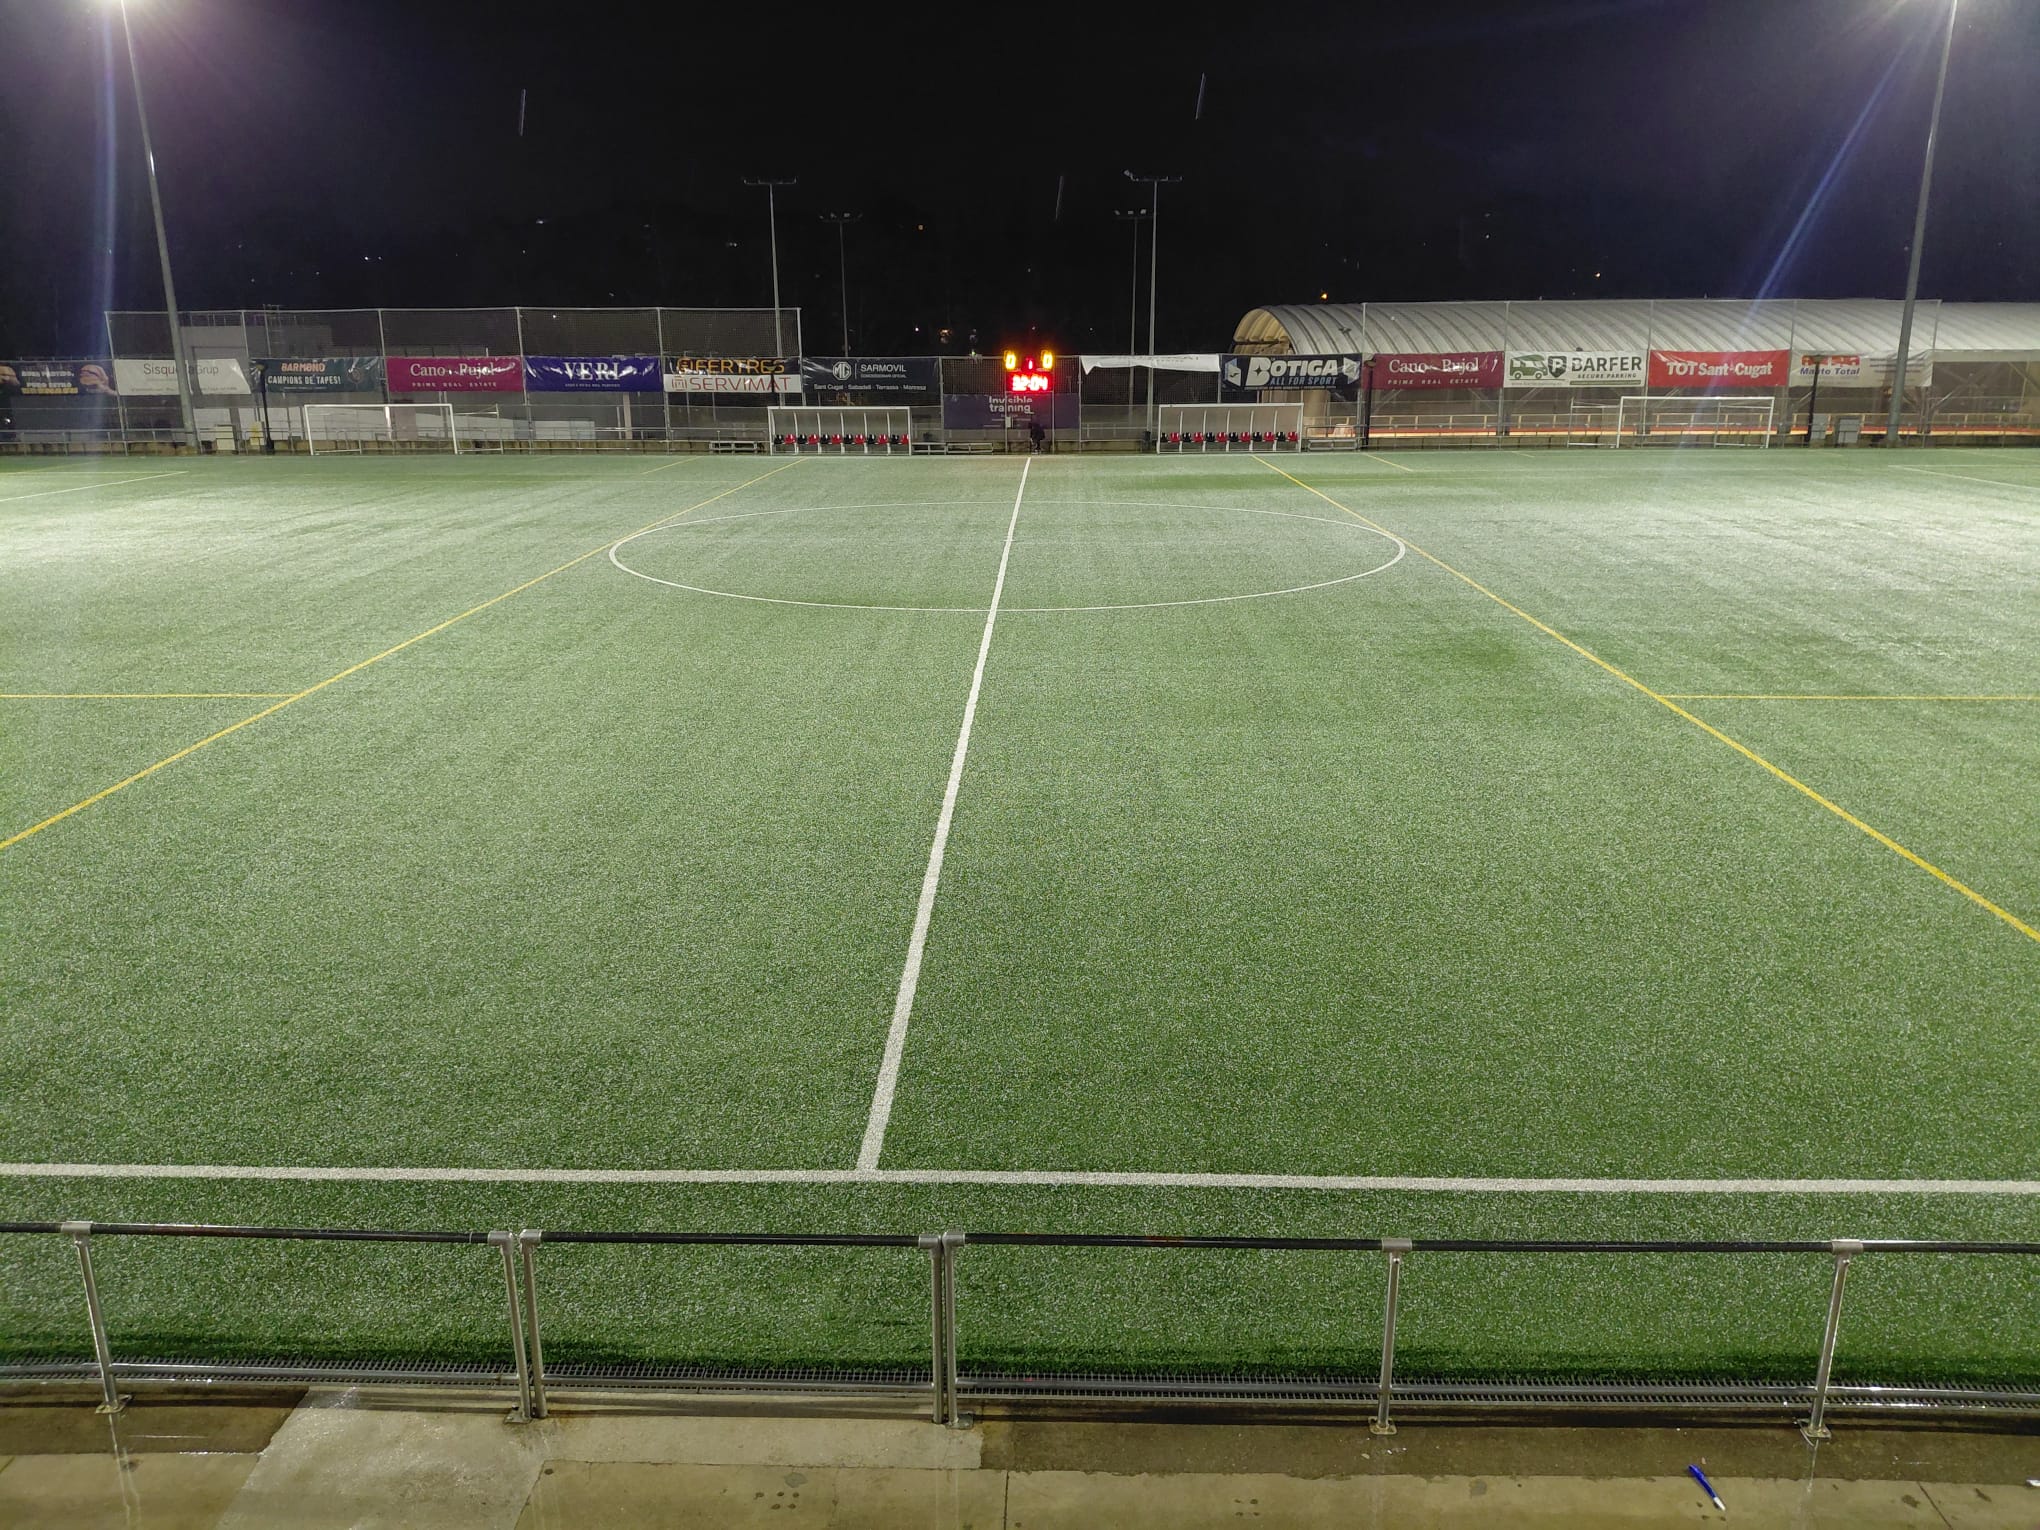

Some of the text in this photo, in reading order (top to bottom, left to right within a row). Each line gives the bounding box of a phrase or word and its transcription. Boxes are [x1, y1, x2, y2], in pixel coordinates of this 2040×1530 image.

[410, 362, 495, 379] Cano Pujol
[695, 360, 785, 374] FERTRES
[860, 364, 907, 372] SARMOVIL
[1389, 357, 1479, 375] Cano Pujol
[1571, 356, 1642, 372] BARFER
[1666, 361, 1773, 378] TOT Sant Cugat
[1834, 367, 1860, 375] Total
[1245, 357, 1338, 386] BOTIGA
[267, 375, 303, 385] CAMPIONS
[304, 376, 313, 385] DE
[689, 377, 791, 391] SERVIMAT
[827, 383, 843, 391] Cugat
[1269, 377, 1337, 385] ALL FOR SPORT
